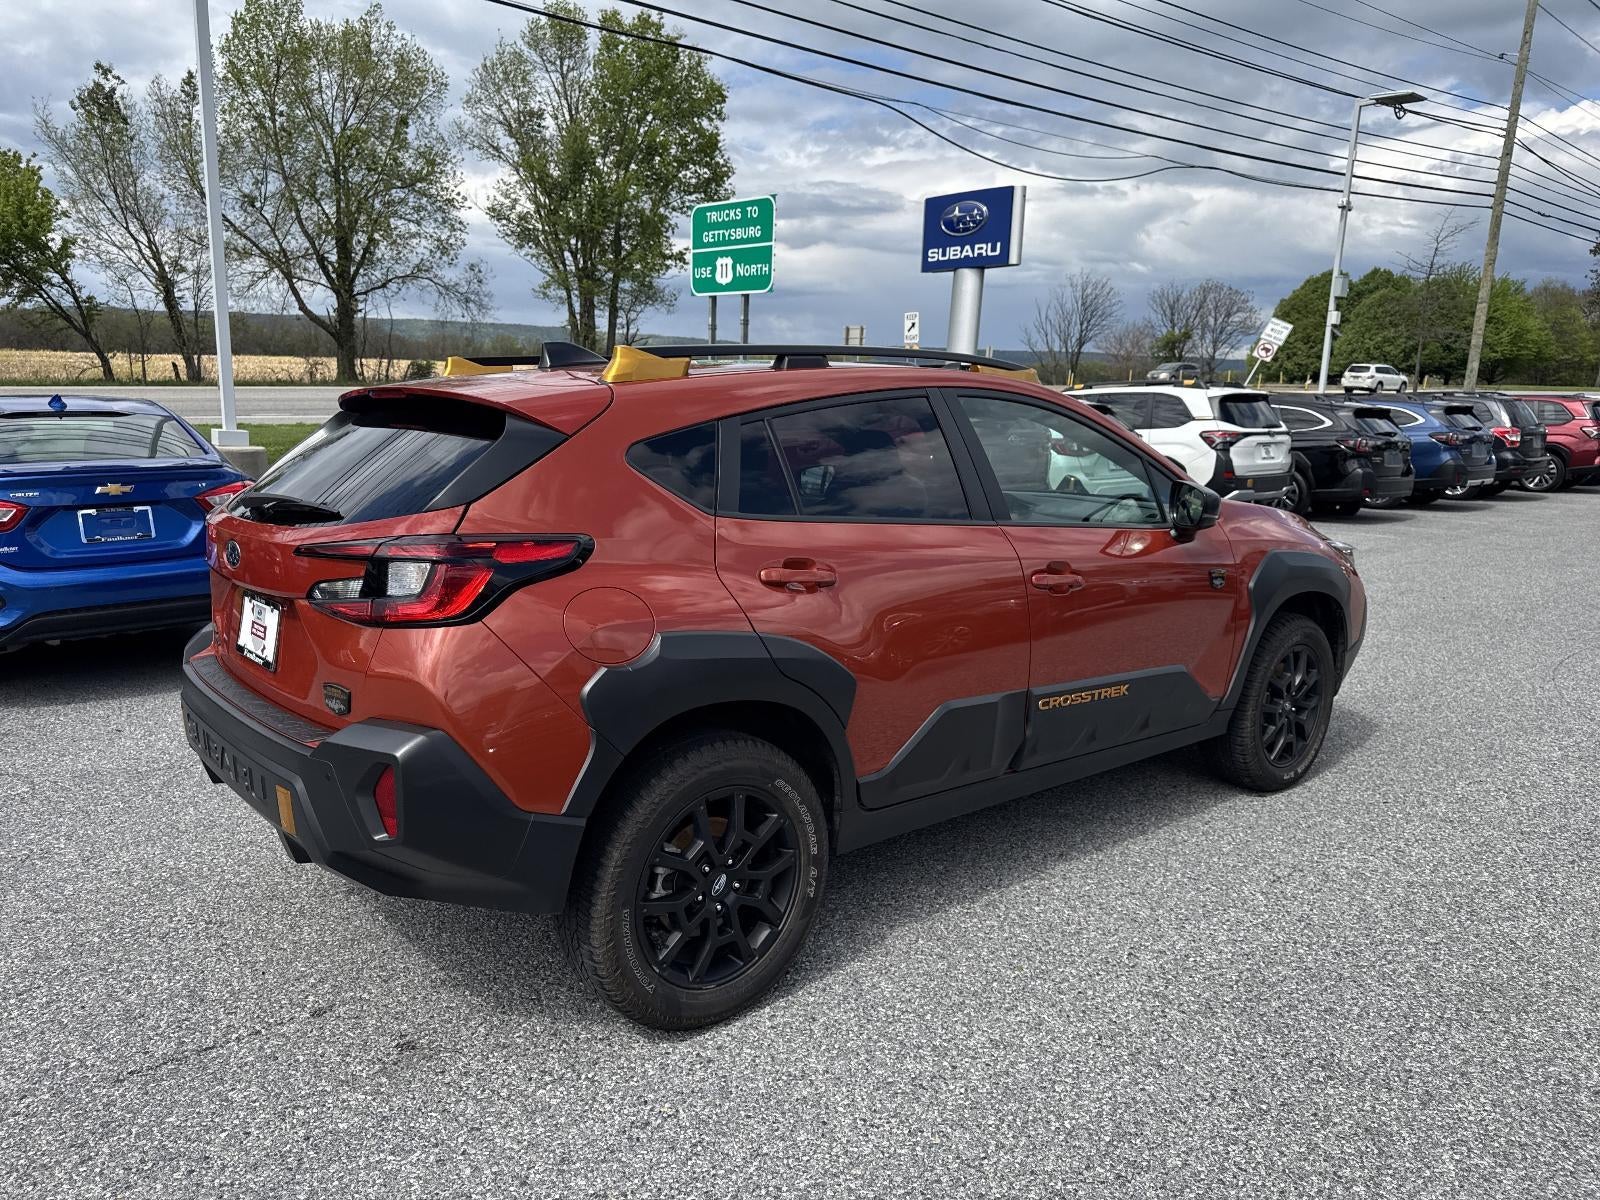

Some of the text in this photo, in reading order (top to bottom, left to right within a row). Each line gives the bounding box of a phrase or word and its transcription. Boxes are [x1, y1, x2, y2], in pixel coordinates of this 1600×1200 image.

[706, 206, 759, 223] TRUCKS TO
[702, 226, 761, 243] GETTYSBURG
[927, 241, 1001, 262] SUBARU
[694, 263, 769, 279] USE 11 NORTH
[906, 313, 917, 321] KEEP
[1038, 683, 1130, 711] CROSSTREK
[775, 779, 818, 855] GEOLANDAR
[622, 909, 656, 994] YOKOHAMA
